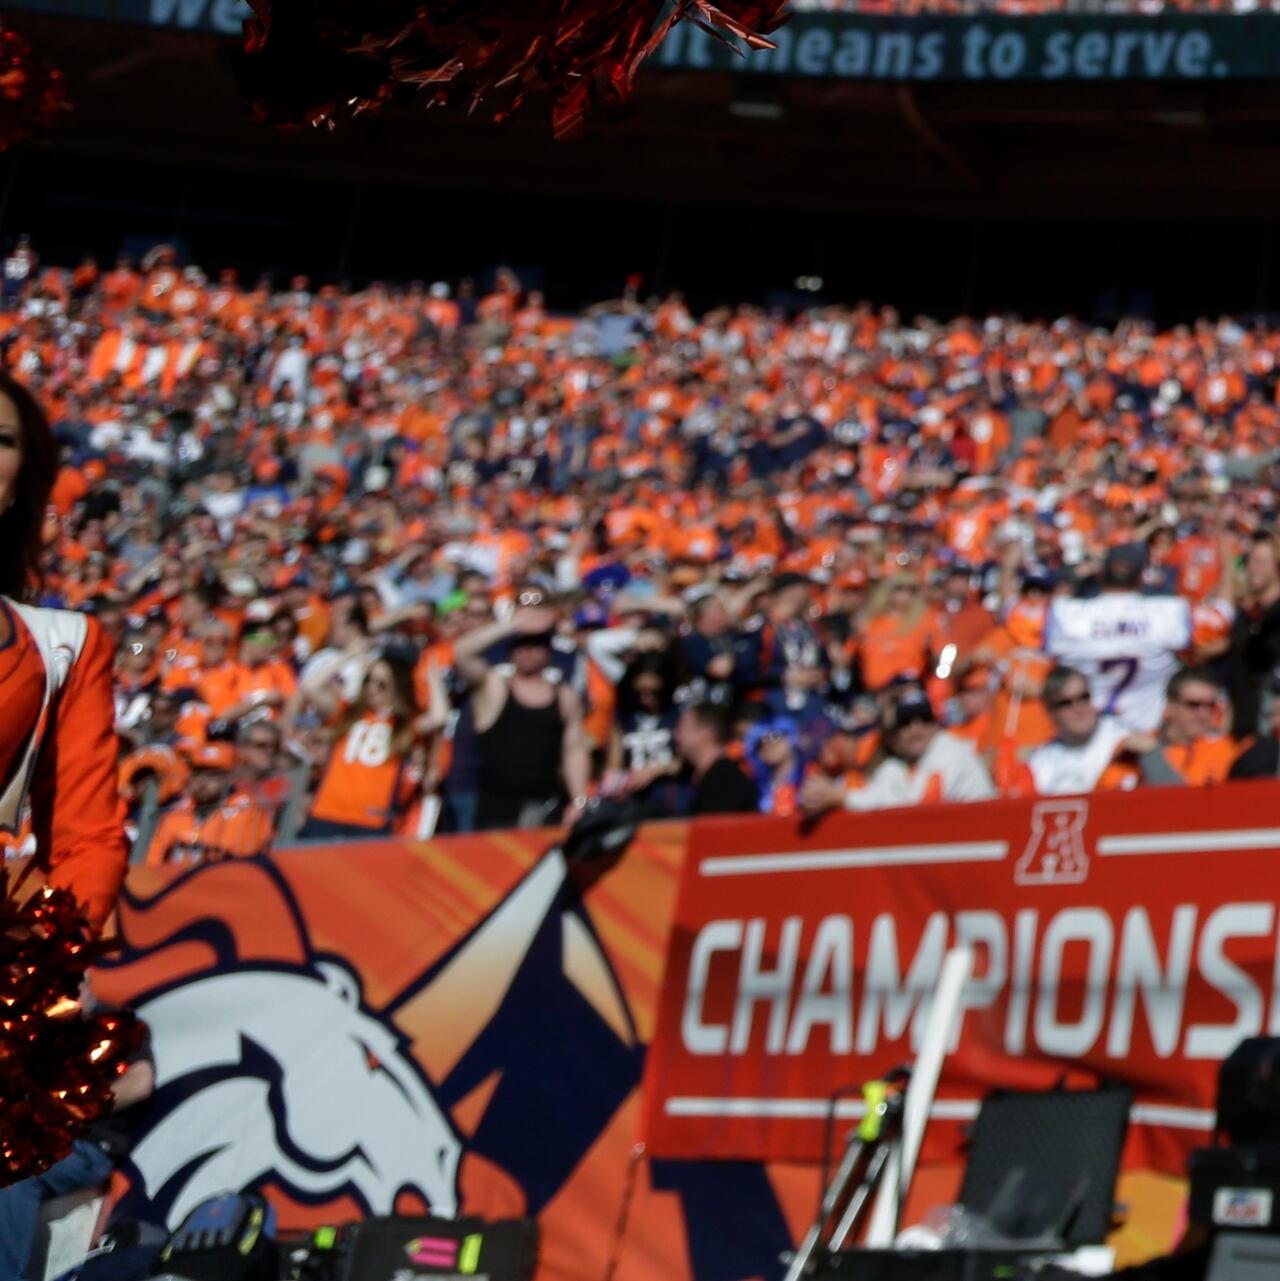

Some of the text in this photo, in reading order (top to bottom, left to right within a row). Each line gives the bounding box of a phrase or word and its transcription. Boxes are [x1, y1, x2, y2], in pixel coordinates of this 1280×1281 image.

[963, 23, 1026, 77] to
[1041, 25, 1228, 77] serve.
[1099, 656, 1139, 716] 7
[343, 718, 393, 767] 18
